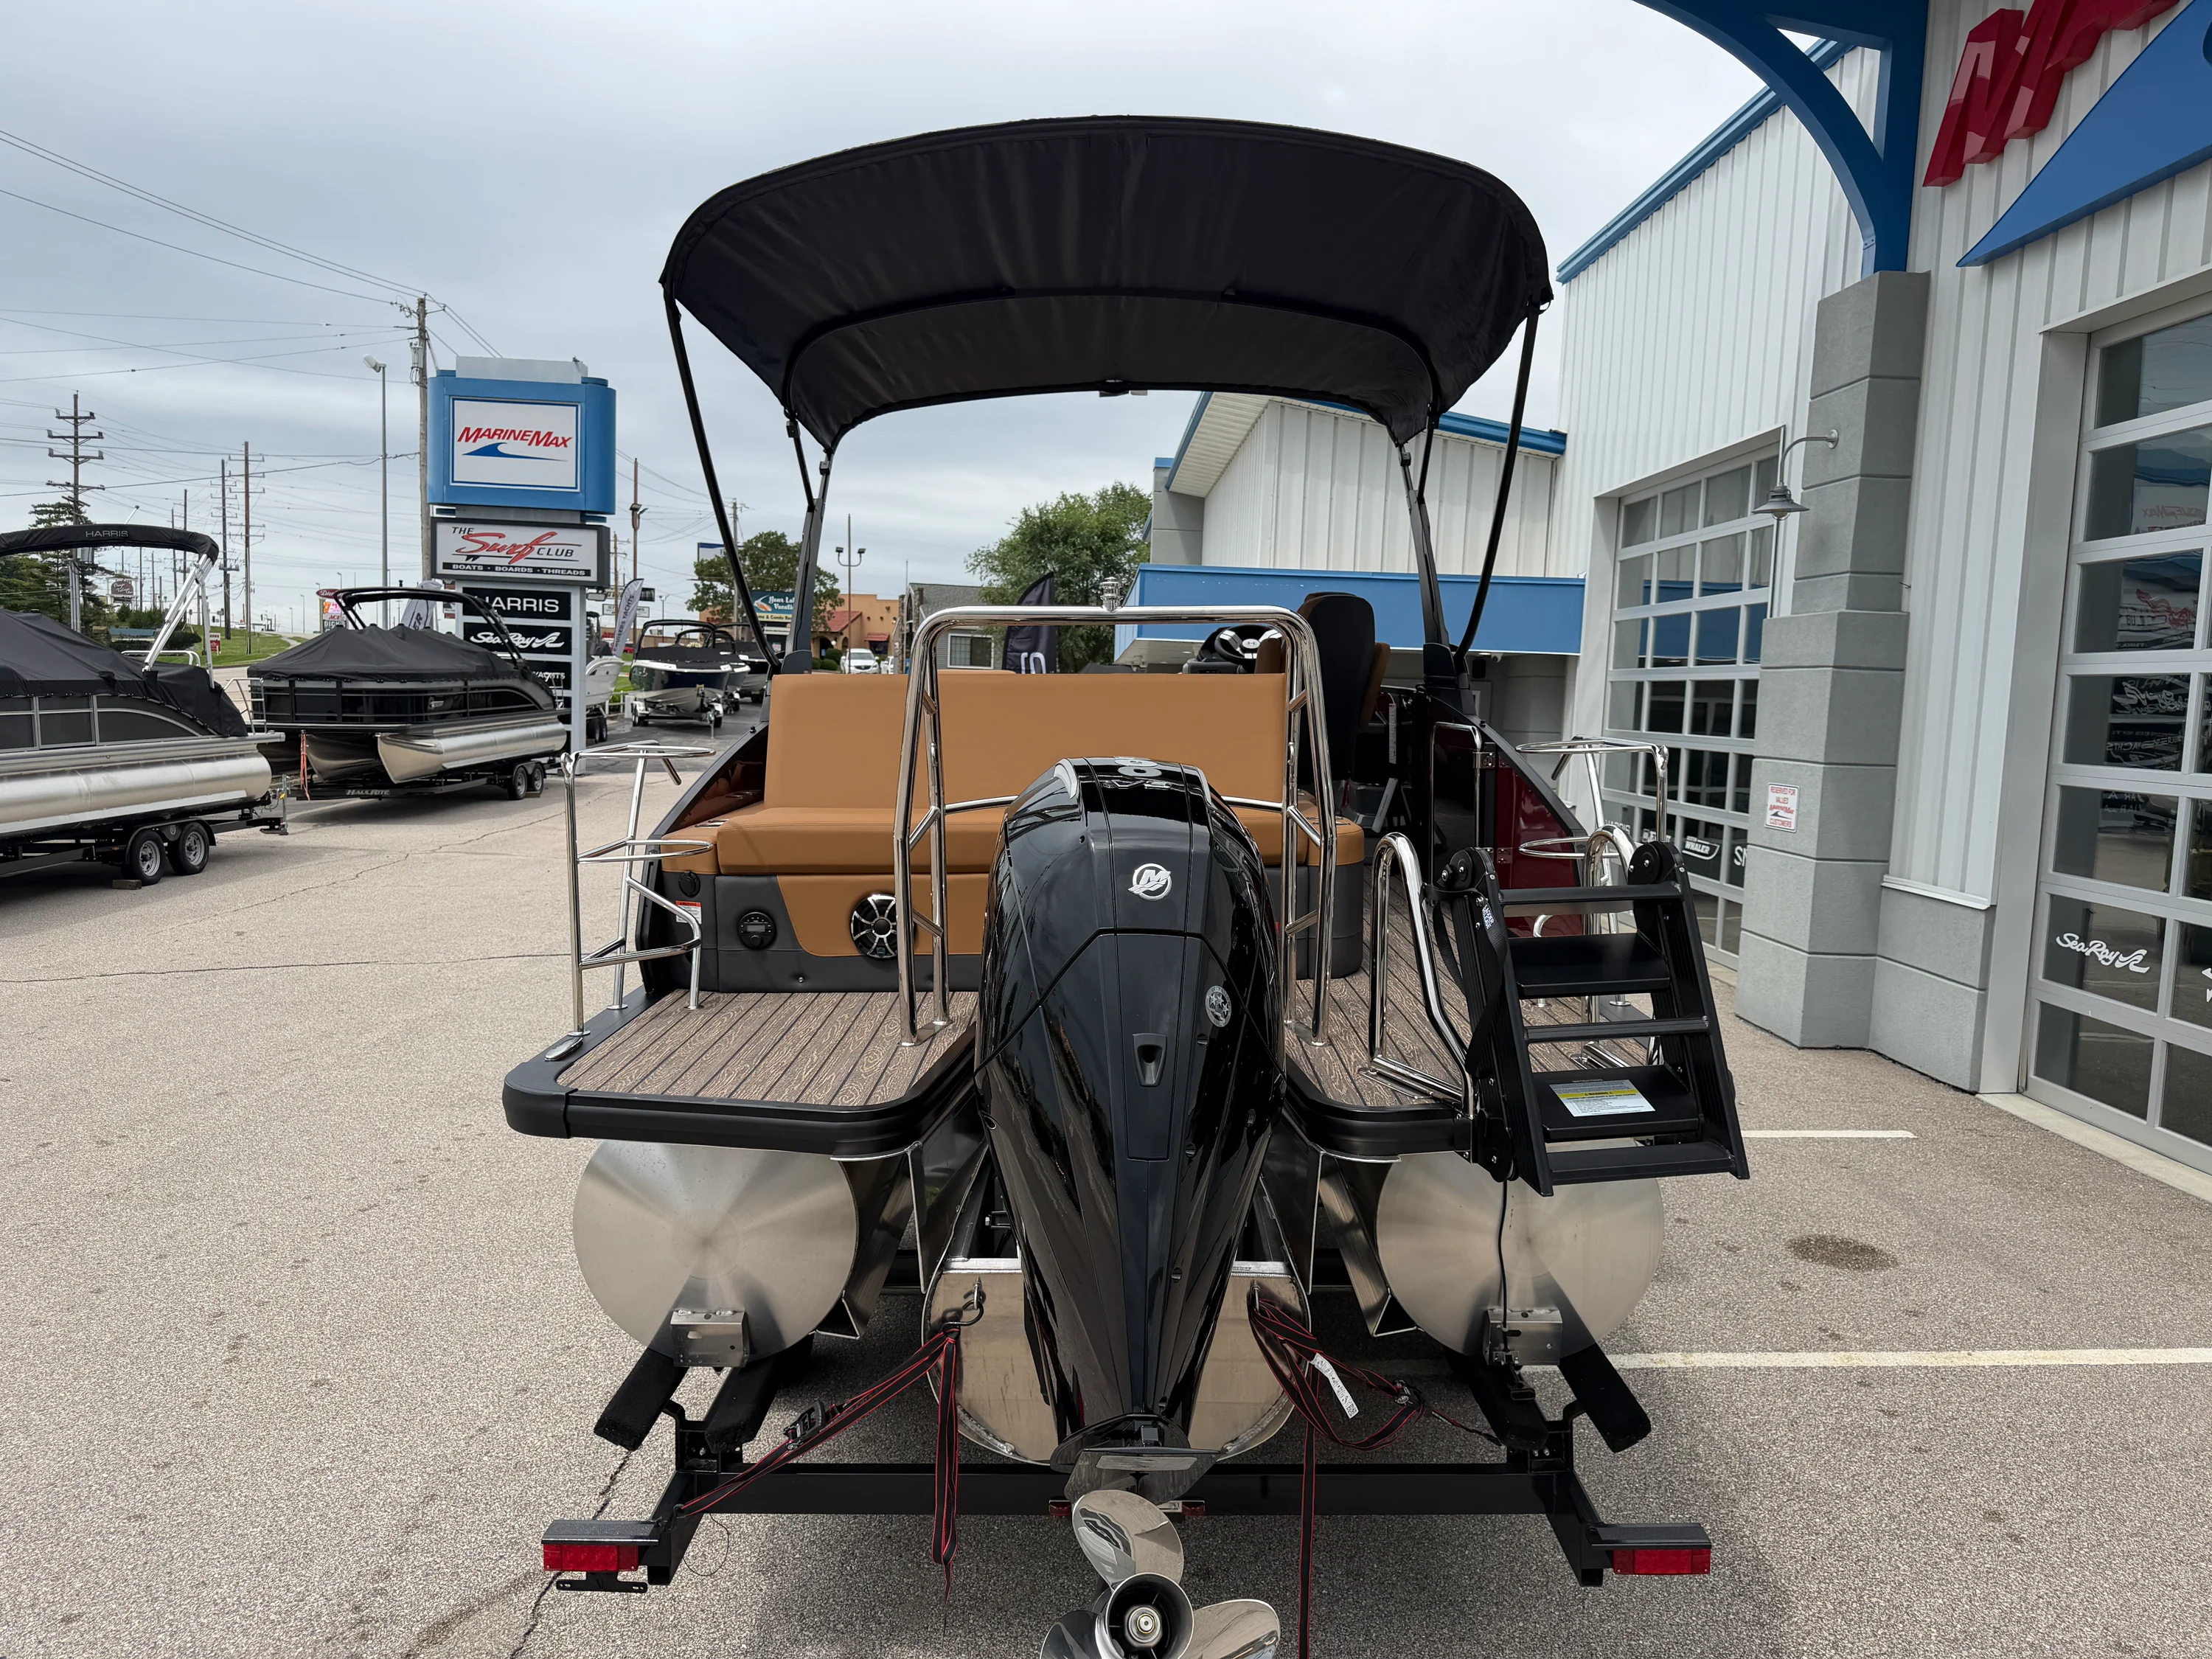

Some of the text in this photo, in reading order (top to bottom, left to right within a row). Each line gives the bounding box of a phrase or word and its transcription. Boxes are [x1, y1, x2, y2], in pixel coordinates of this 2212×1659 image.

[457, 426, 574, 448] MARINEMAX
[452, 526, 475, 535] THE
[456, 531, 582, 565] Surf CLUB
[452, 563, 484, 571] BOATS
[542, 568, 586, 576] THREADS
[477, 596, 560, 613] ARRIS
[622, 594, 635, 620] YACHTS
[1685, 841, 1711, 855] WHALER
